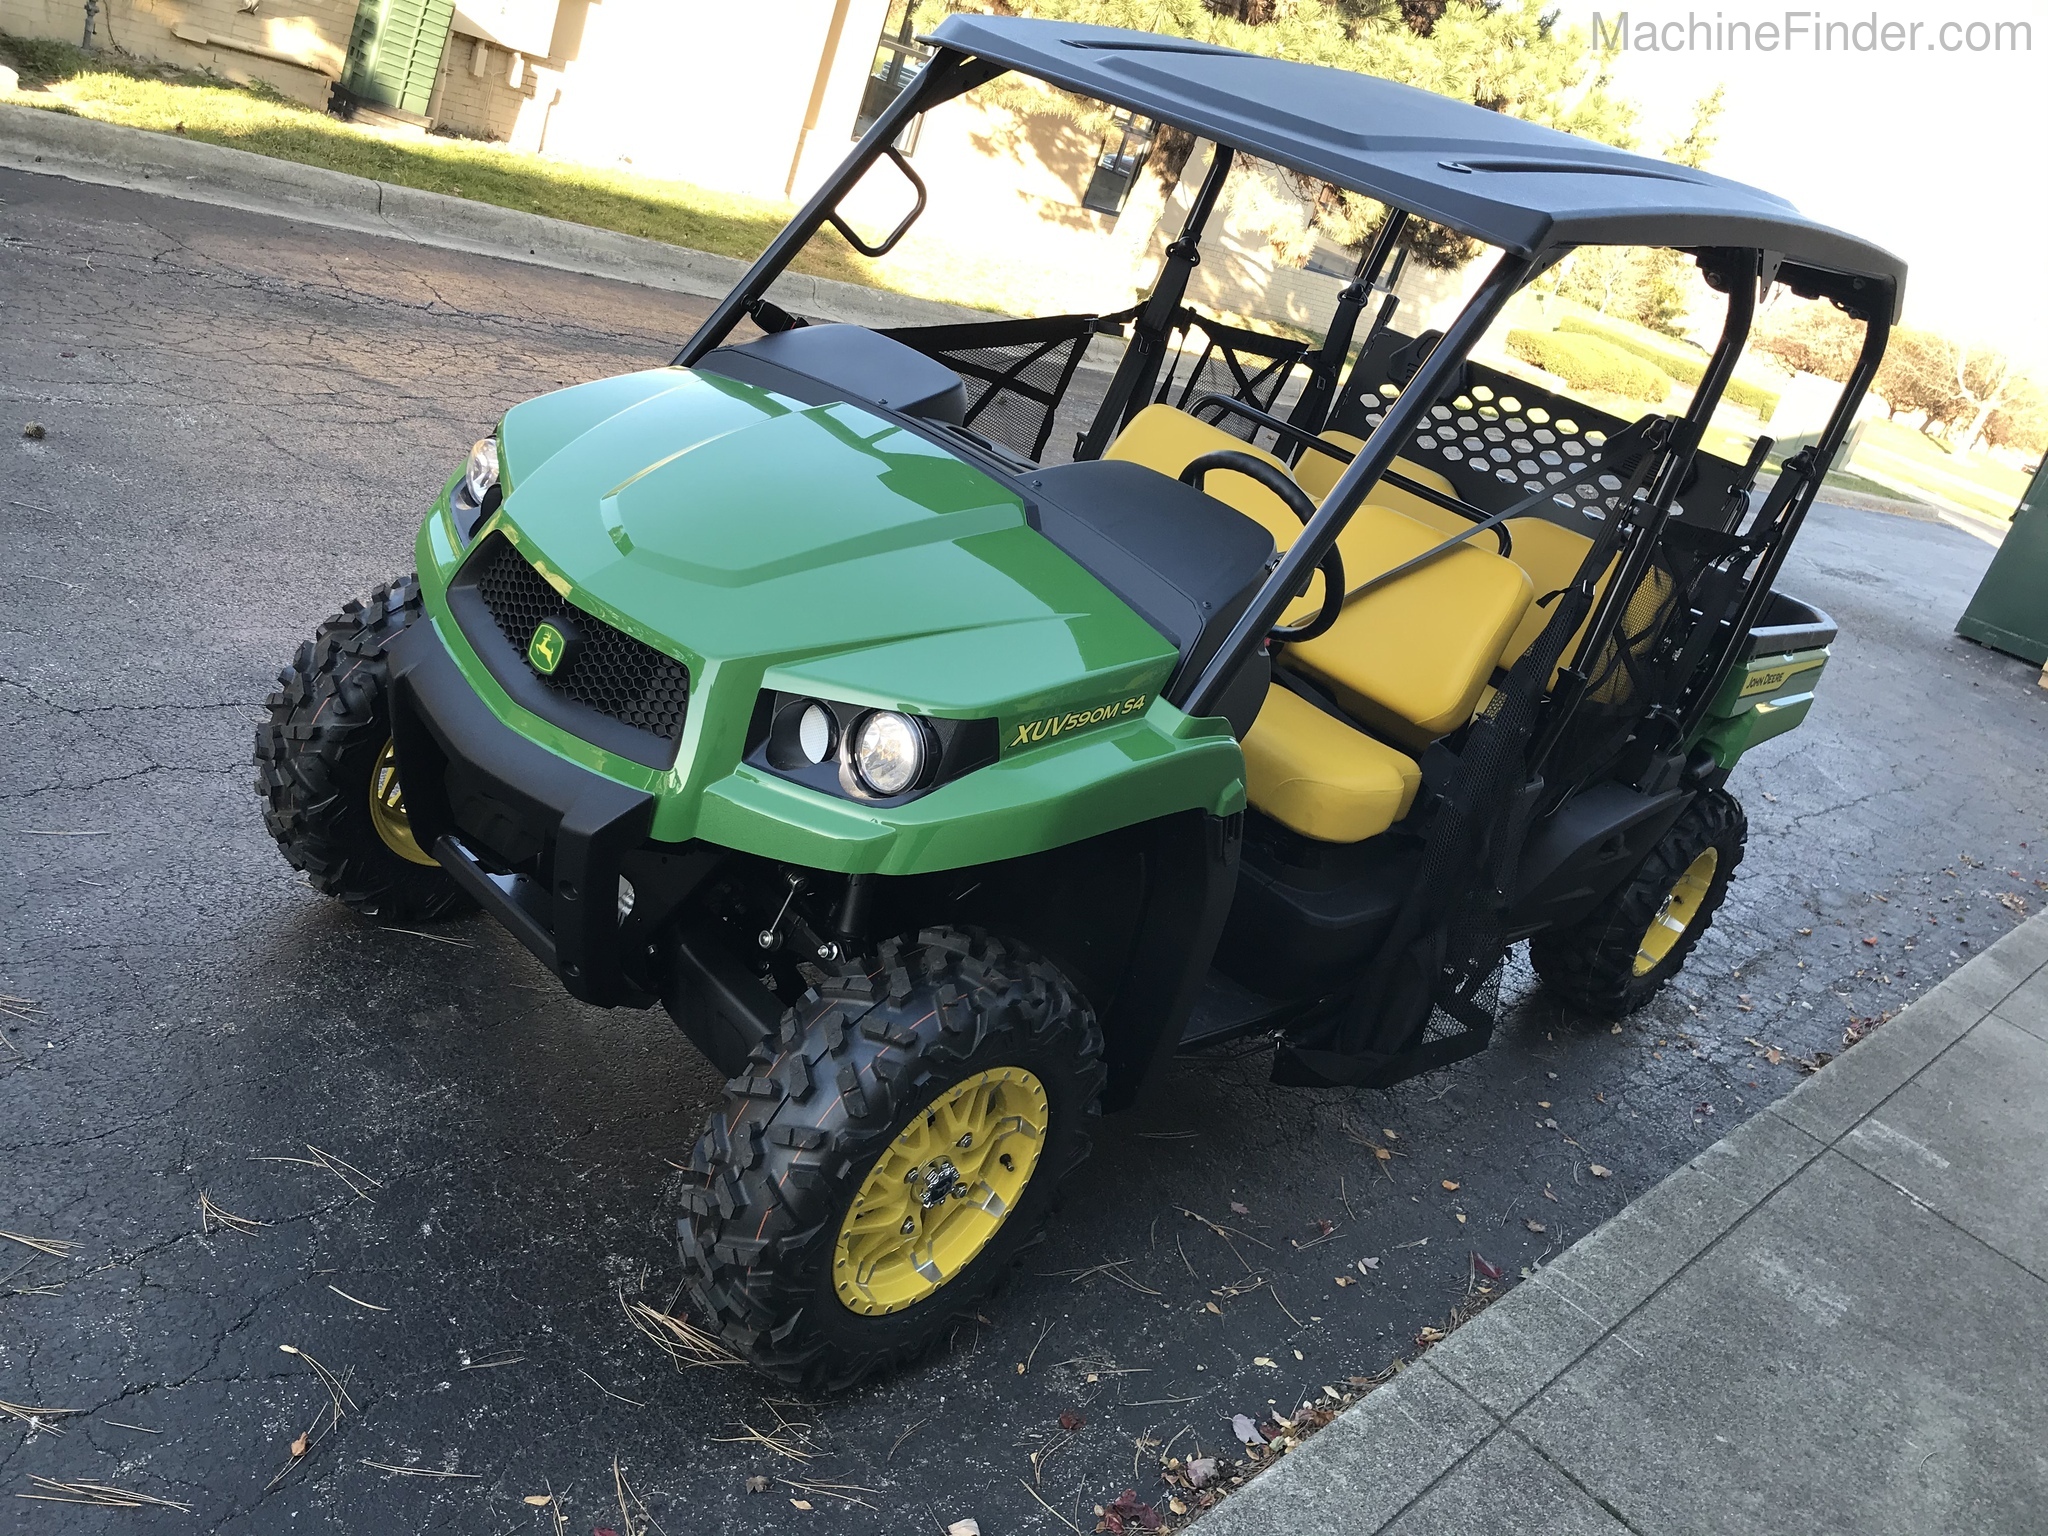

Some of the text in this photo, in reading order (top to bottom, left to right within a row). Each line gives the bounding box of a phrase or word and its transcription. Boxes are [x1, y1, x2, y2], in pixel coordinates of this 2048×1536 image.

[1746, 672, 1784, 689] JOHN DEERE
[1010, 694, 1146, 747] XUV590M S4
